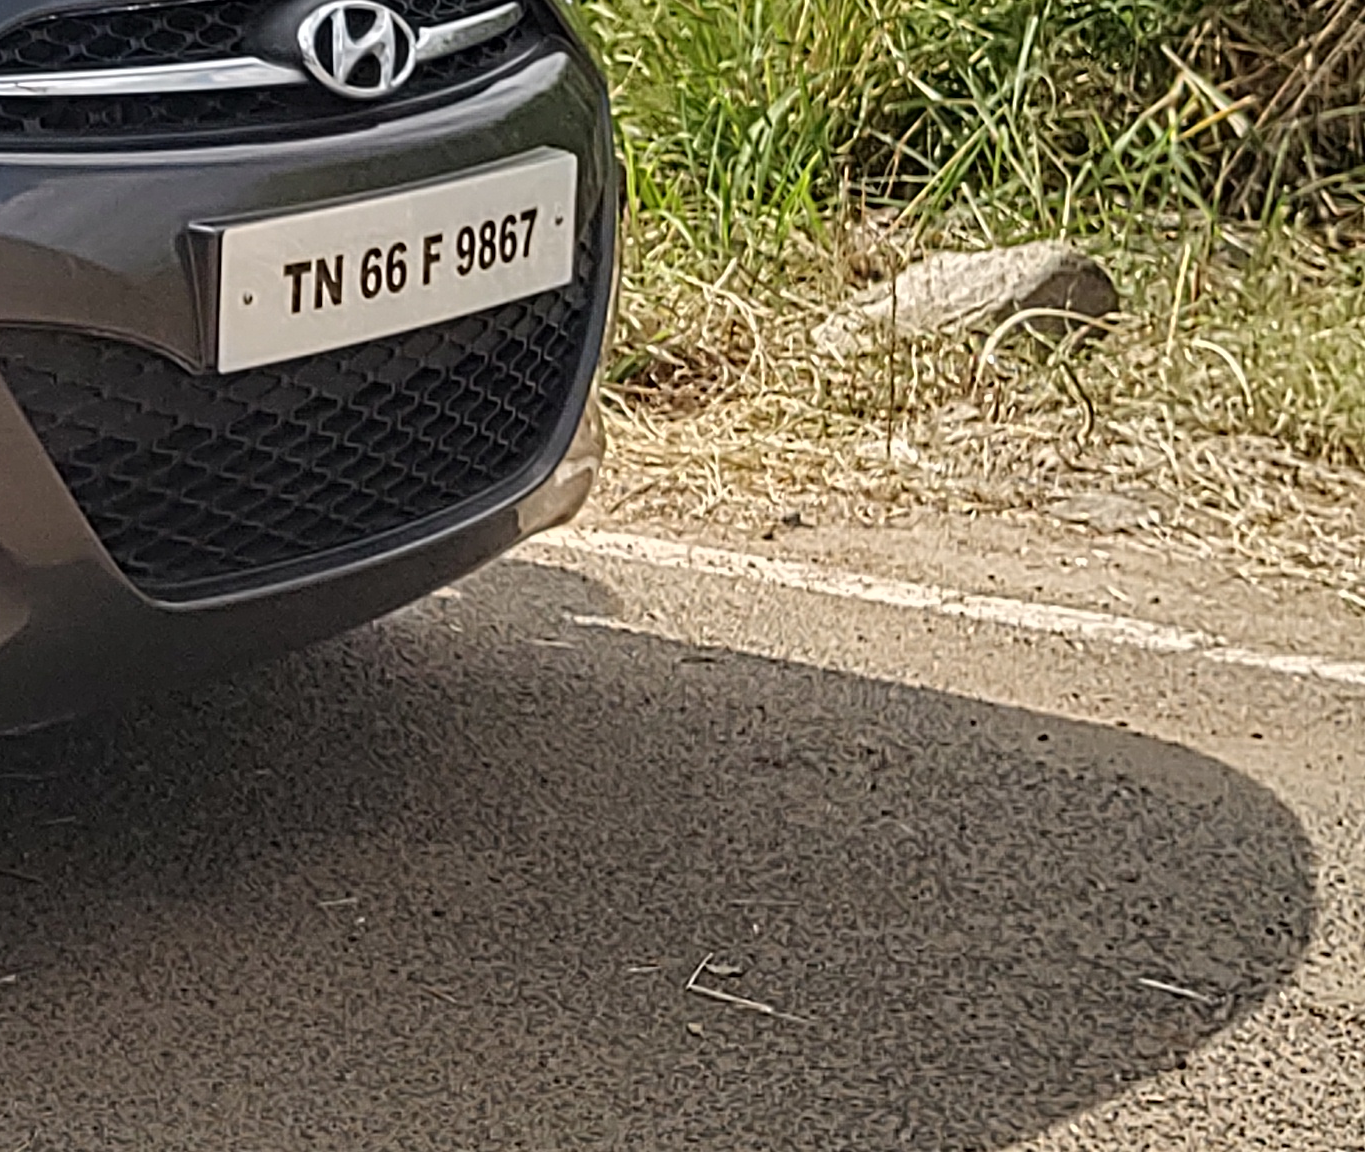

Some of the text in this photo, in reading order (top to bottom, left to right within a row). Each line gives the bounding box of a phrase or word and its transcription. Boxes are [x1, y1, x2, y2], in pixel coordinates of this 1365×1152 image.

[284, 208, 538, 314] TN 66 F 9867
